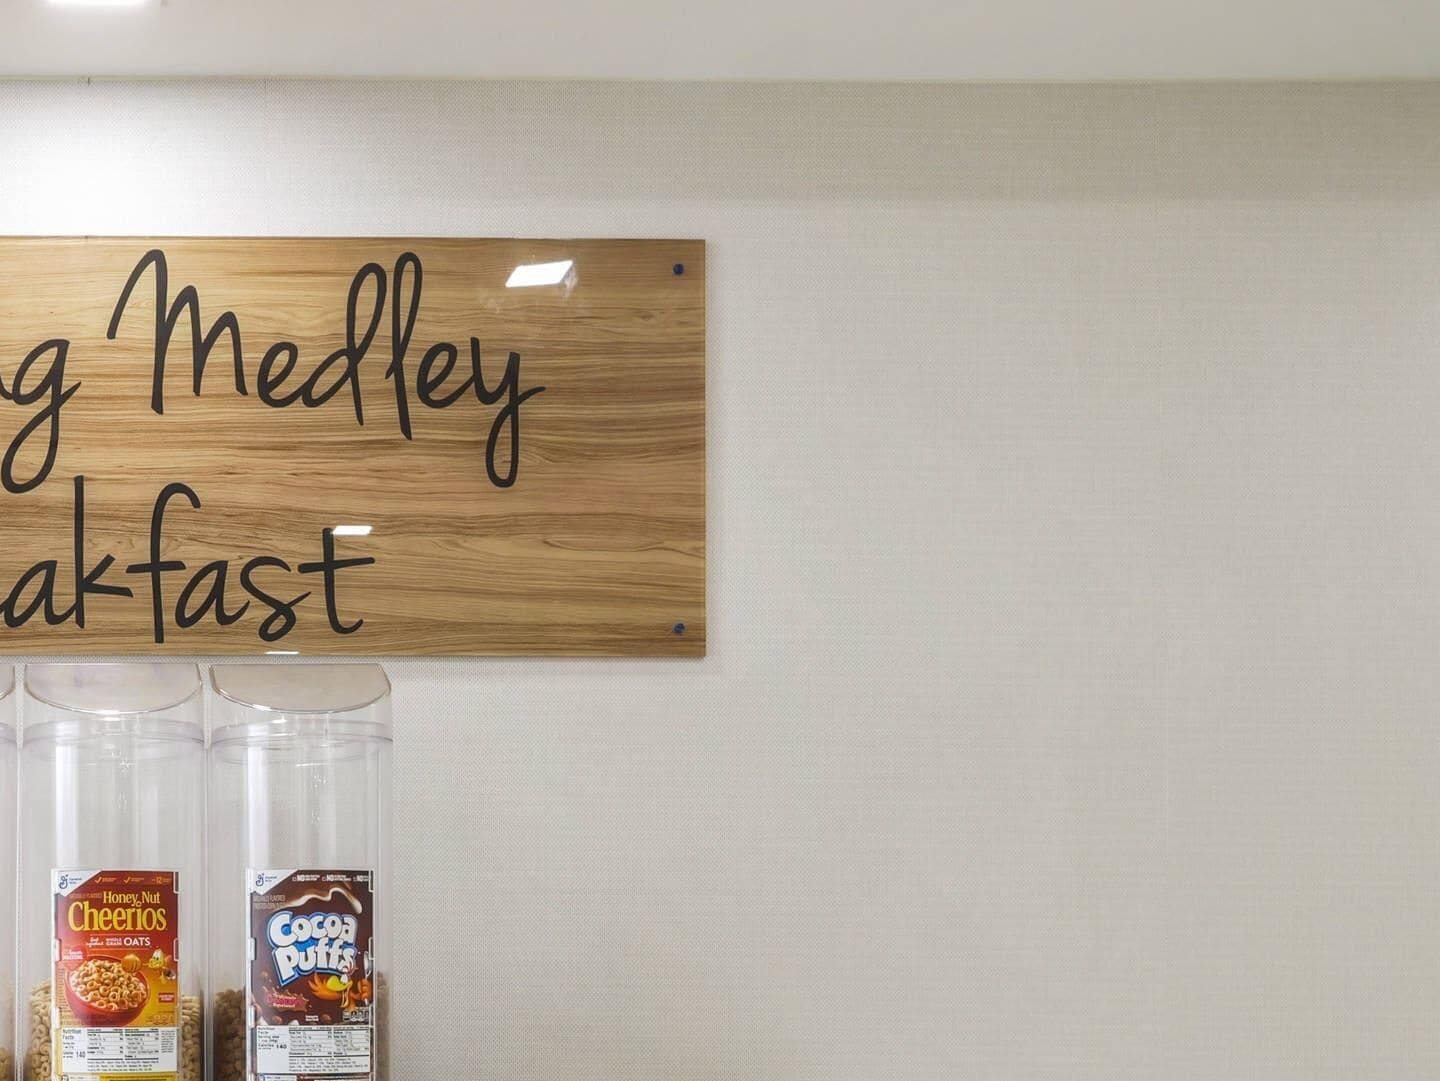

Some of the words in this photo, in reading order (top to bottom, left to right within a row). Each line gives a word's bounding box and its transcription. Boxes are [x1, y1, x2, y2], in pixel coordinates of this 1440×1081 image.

[107, 249, 546, 488] Medley
[103, 891, 138, 906] Honey
[141, 891, 160, 903] Nut
[68, 901, 167, 931] Cheerios
[269, 913, 357, 947] Cocoa
[123, 937, 151, 946] OATS
[274, 937, 356, 981] Puffs
